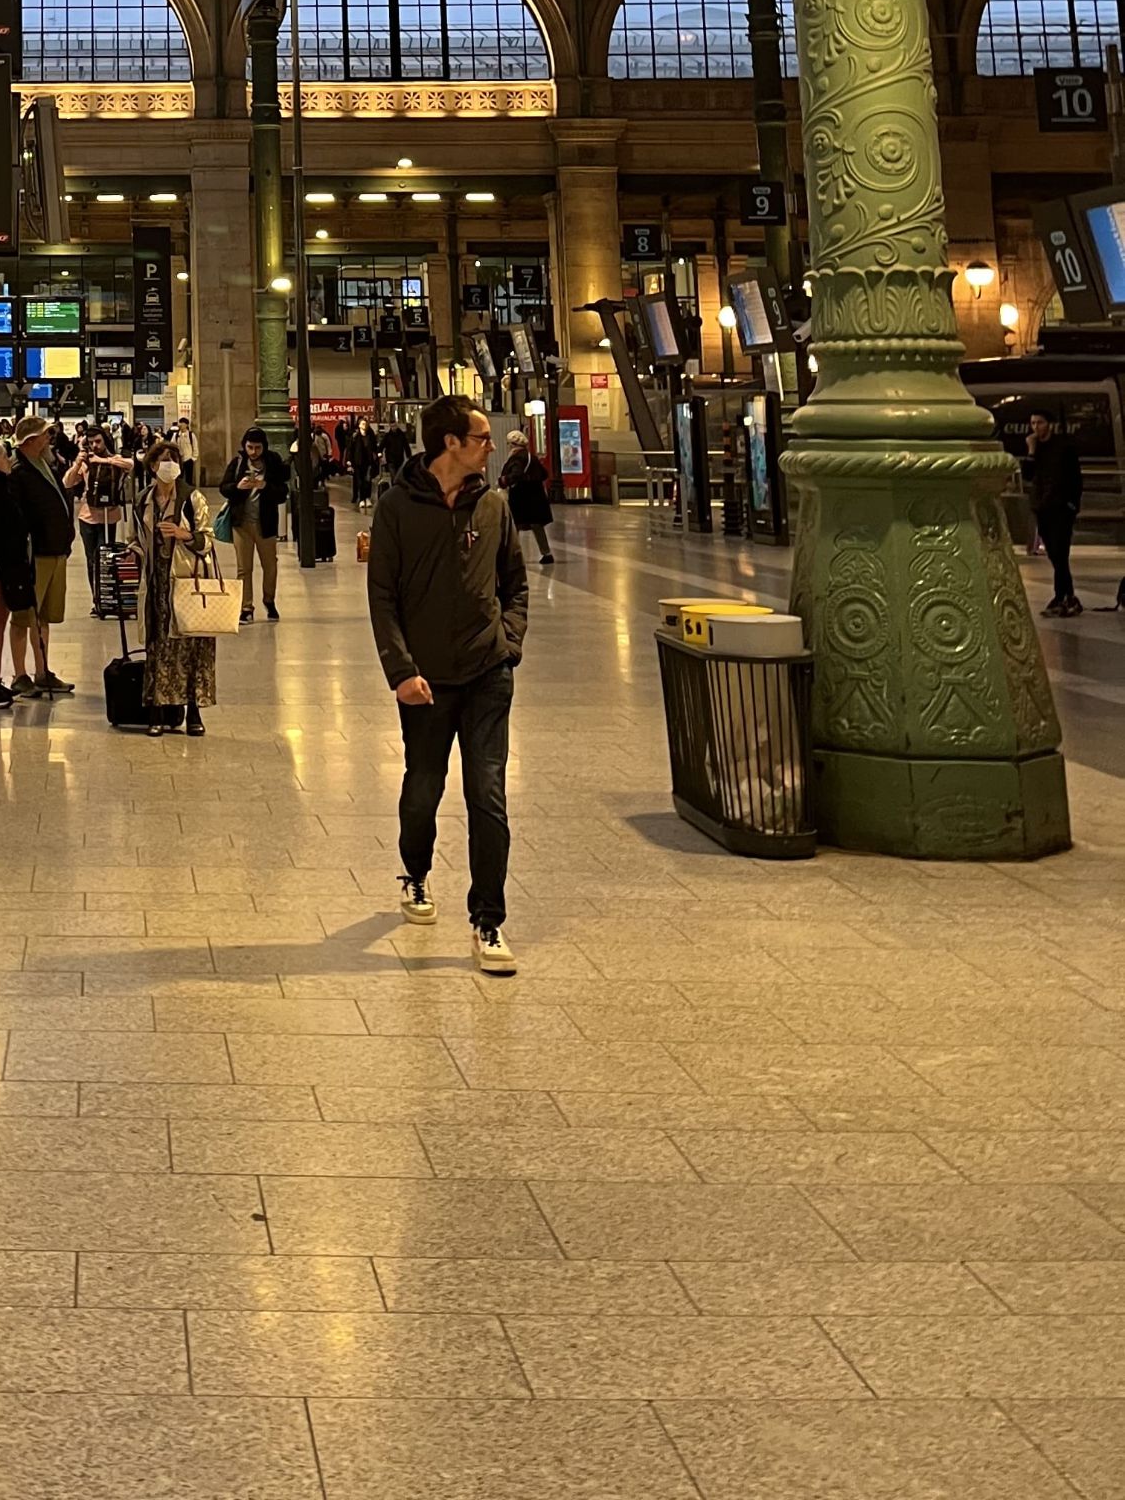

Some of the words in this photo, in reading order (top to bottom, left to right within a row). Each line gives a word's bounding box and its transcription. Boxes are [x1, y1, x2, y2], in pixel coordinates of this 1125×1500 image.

[1052, 87, 1093, 117] 10
[756, 196, 769, 215] 9
[637, 236, 649, 253] 8
[146, 263, 158, 278] P
[1055, 248, 1082, 285] 10
[523, 275, 533, 288] 7
[472, 293, 481, 305] 6
[414, 313, 422, 324] 5
[772, 300, 782, 325] 9
[387, 321, 394, 331] 4
[360, 331, 366, 341] 3
[339, 340, 345, 348] 2
